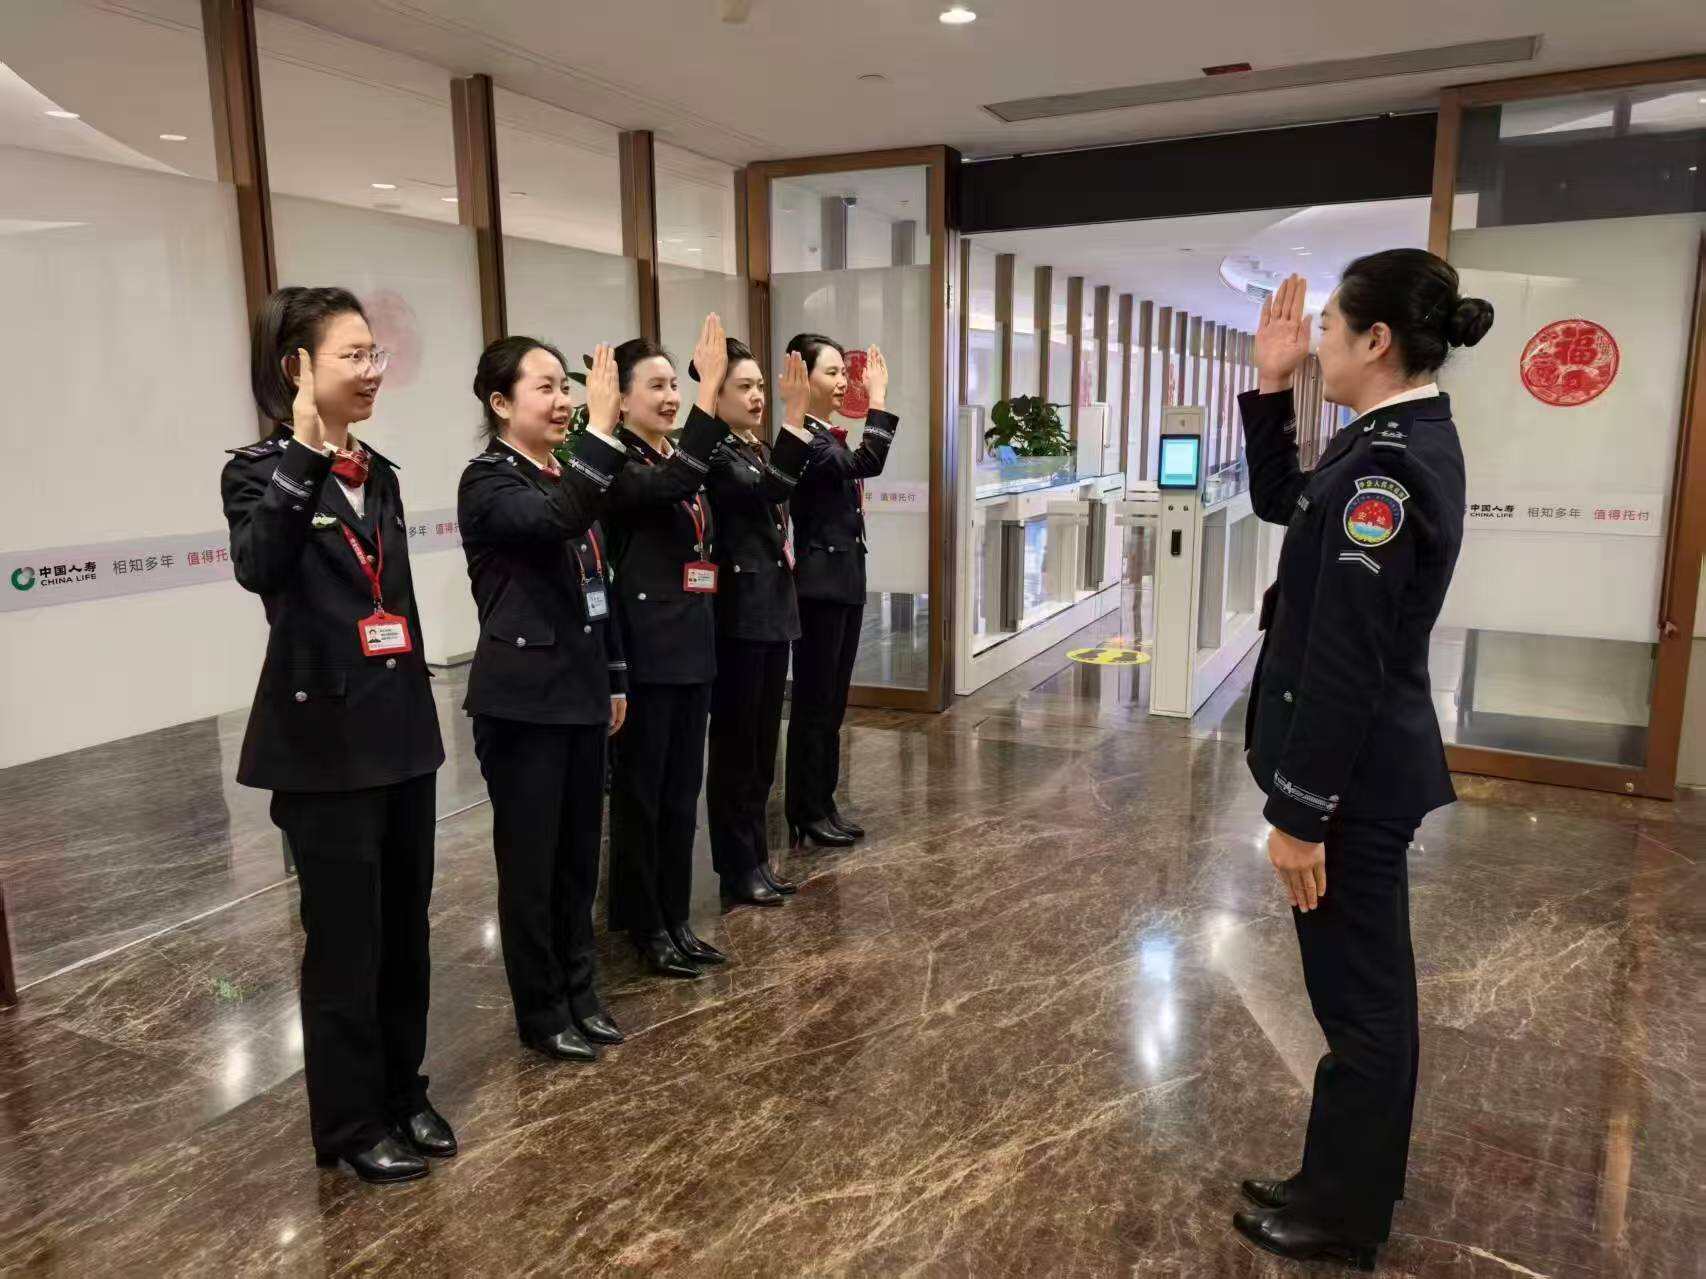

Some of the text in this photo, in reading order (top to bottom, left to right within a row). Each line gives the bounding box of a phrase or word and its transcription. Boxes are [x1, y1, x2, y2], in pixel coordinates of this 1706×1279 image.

[1470, 504, 1515, 513] 中国人寿
[1527, 506, 1649, 521] 相知多年 值得托付
[408, 524, 427, 538] 多年
[39, 561, 97, 579] 中国人寿
[112, 554, 175, 575] 相知多年
[40, 573, 97, 588] CHINA LIFE
